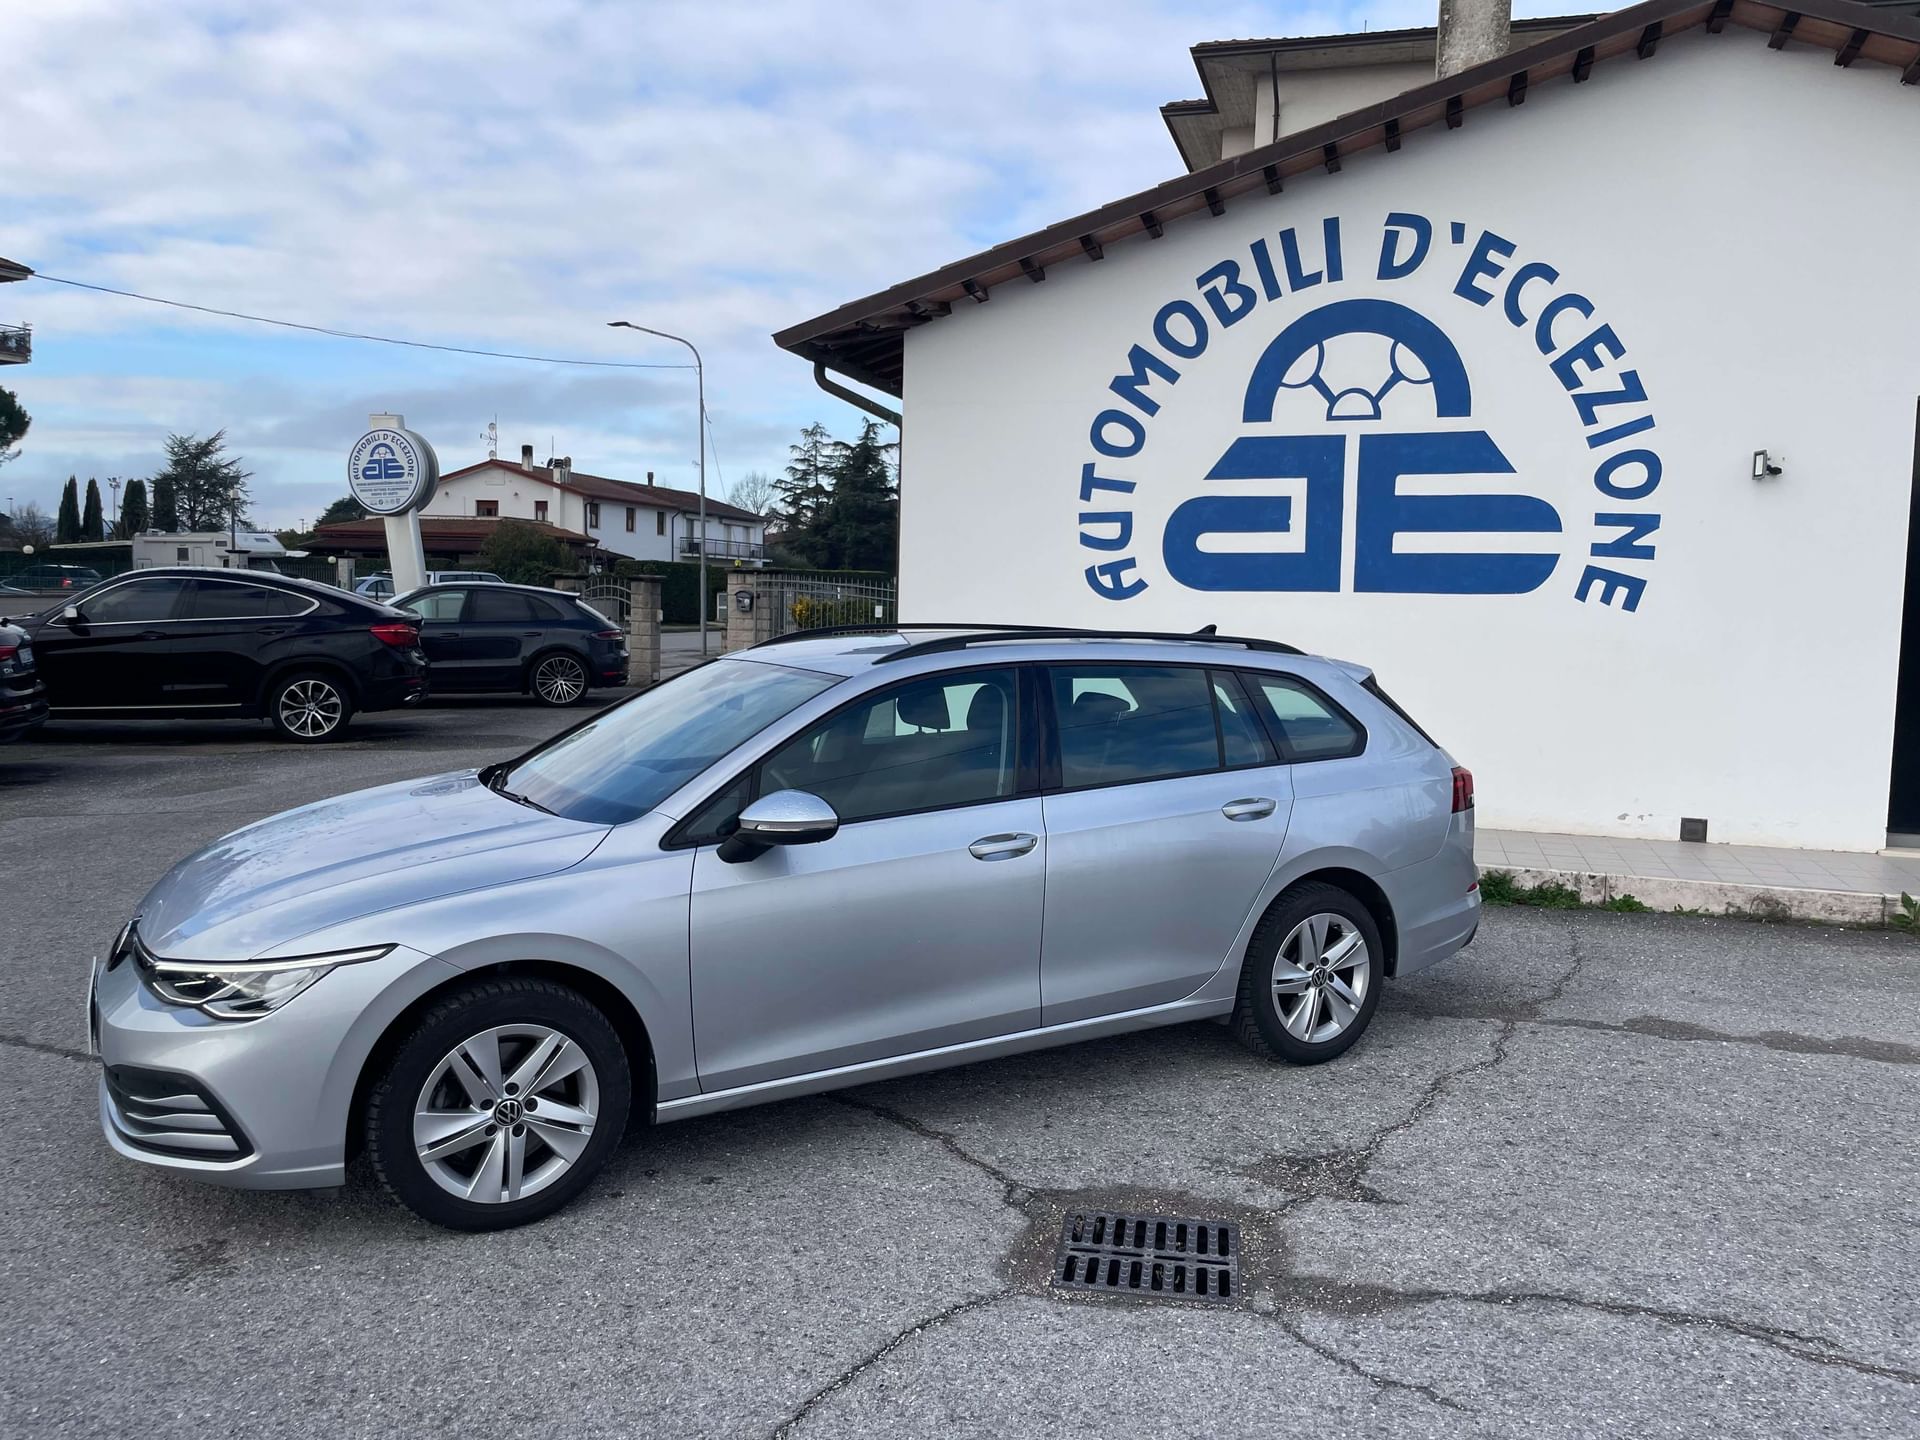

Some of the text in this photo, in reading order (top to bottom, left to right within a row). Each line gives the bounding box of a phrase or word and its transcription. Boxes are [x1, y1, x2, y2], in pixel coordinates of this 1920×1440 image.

[352, 433, 415, 480] AUTOMOBILI D'ECCEZIONE
[1079, 213, 1662, 613] AUTOMOBILI D'ECCEZIONE
